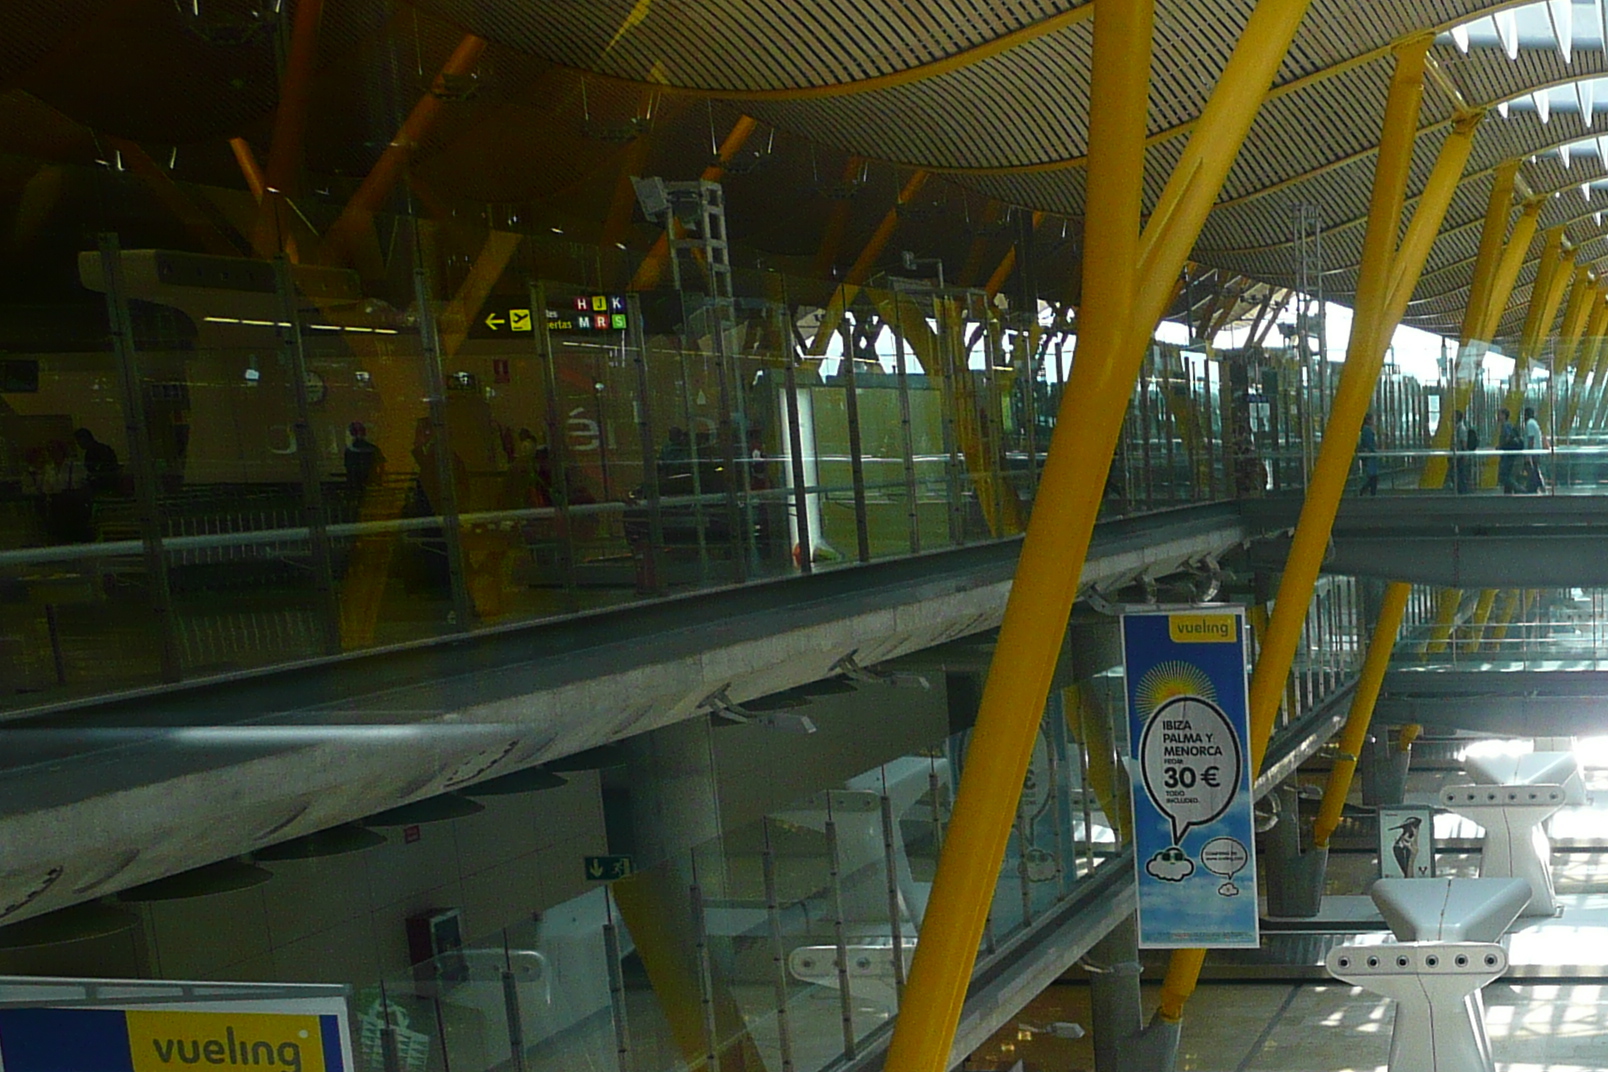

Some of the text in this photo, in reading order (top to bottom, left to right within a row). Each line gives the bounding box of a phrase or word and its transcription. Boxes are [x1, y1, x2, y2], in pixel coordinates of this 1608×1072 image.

[1177, 619, 1228, 637] vueling
[1162, 720, 1191, 731] IBIZA
[1163, 733, 1213, 743] PALMA Y
[1164, 746, 1222, 757] MENORCA
